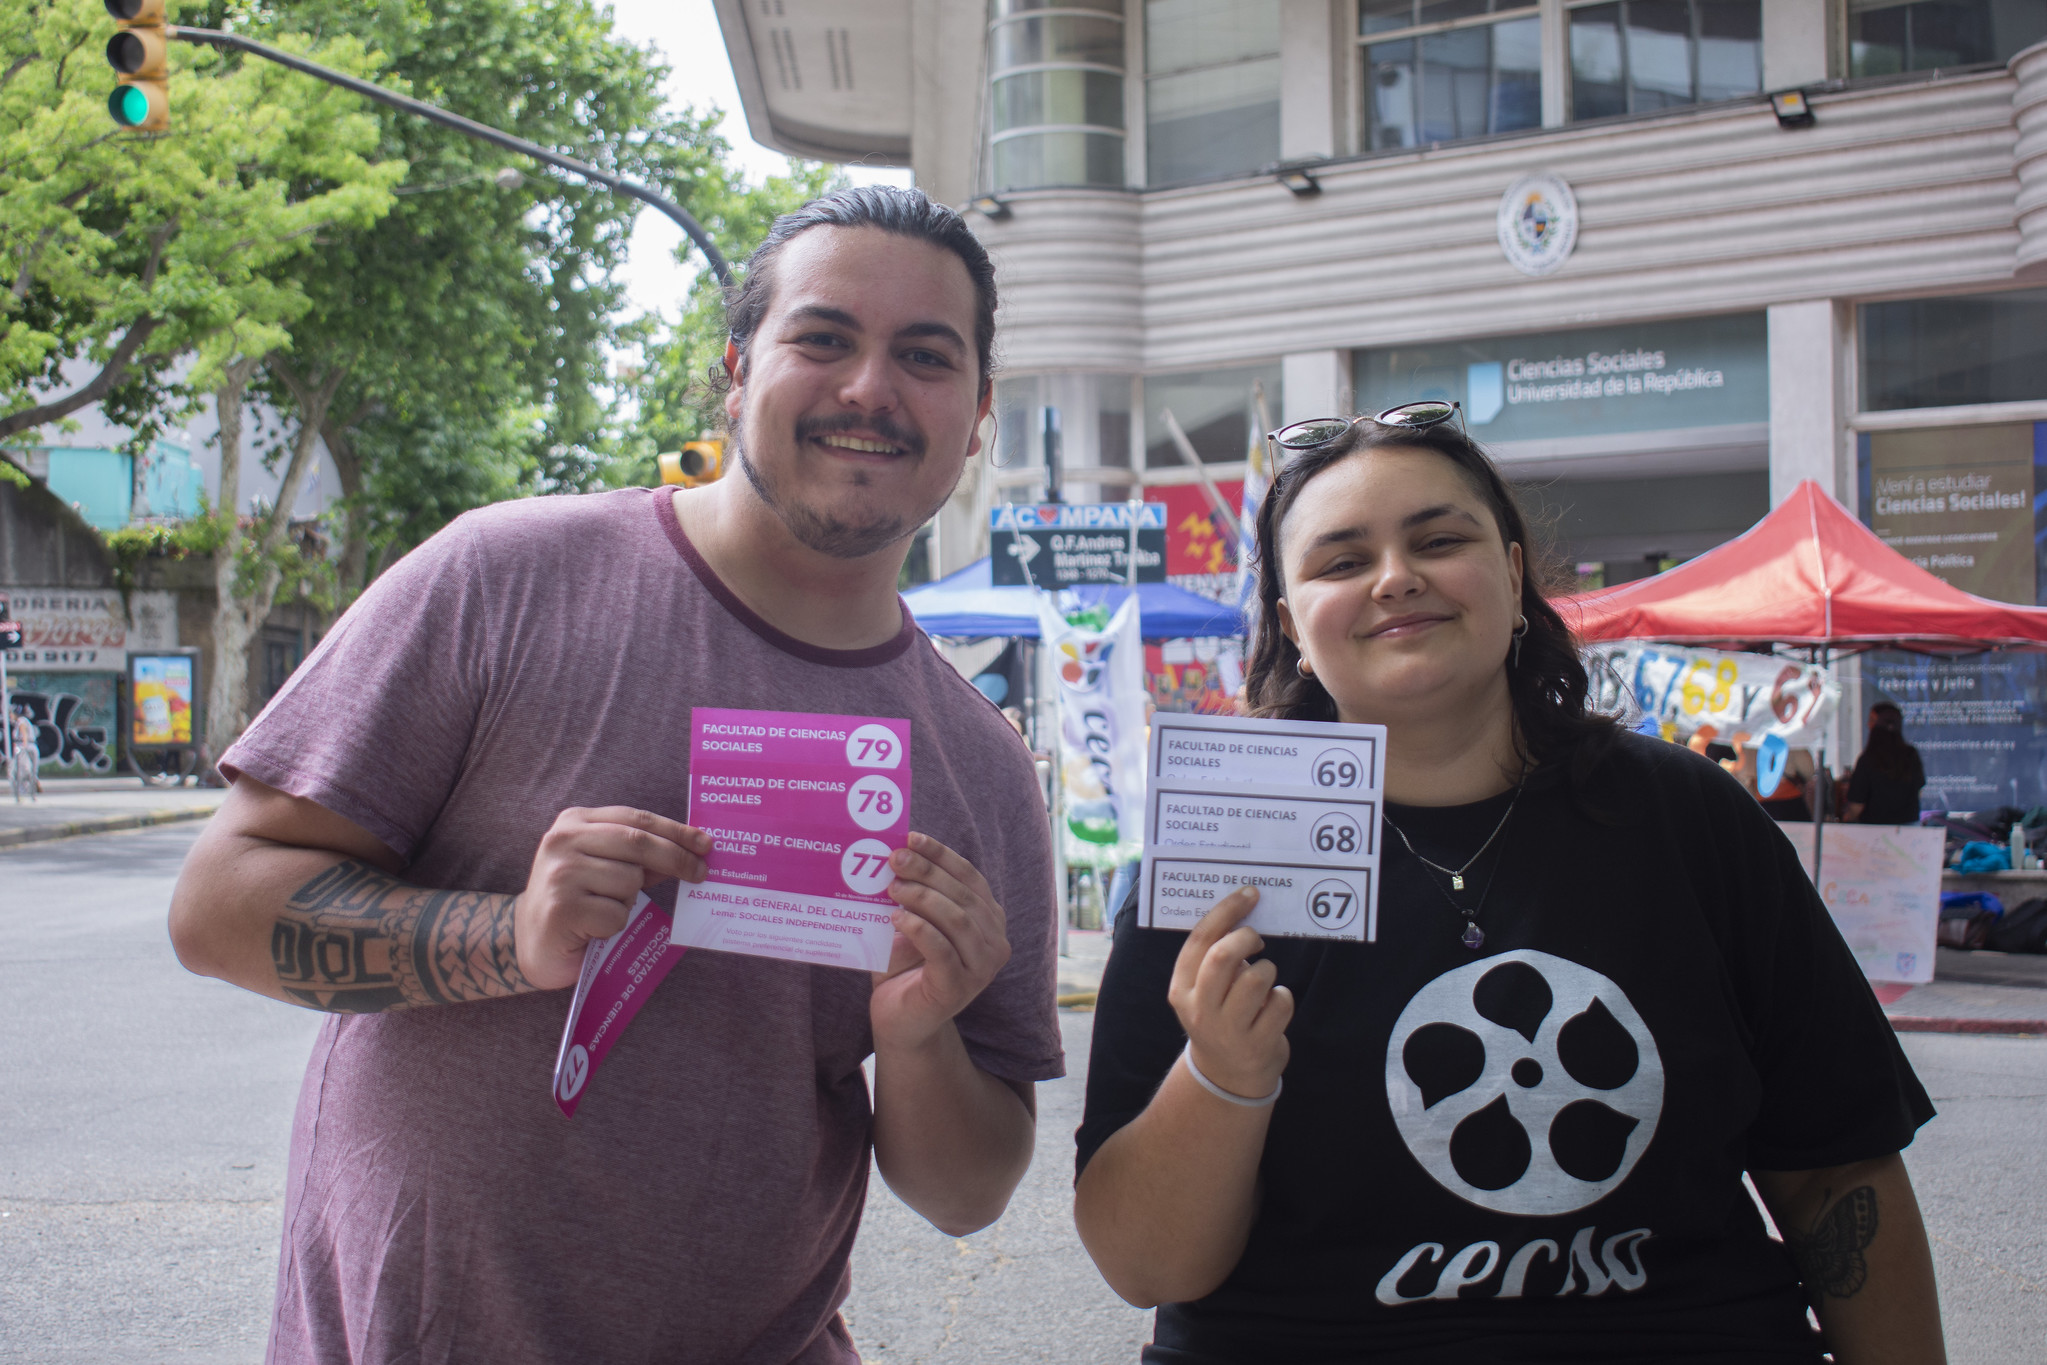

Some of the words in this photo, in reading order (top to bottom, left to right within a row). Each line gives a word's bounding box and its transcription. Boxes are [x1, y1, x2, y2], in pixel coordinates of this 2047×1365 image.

[1507, 355, 1585, 381] Ciencias
[1586, 347, 1666, 375] Sociales
[1507, 377, 1602, 404] Universidad
[1603, 376, 1626, 396] de
[1626, 374, 1643, 394] la
[1643, 368, 1724, 395] República
[1915, 481, 1925, 493] a
[1927, 472, 1992, 493] estudiar
[1875, 495, 1945, 515] Ciencias
[1948, 489, 2026, 512] Sociales!
[1930, 553, 1975, 569] Política
[1683, 657, 1738, 715] 68
[1878, 677, 1929, 691] febrero
[1932, 678, 1940, 692] y
[1942, 676, 1975, 692] julio
[702, 724, 766, 738] FACULTAD
[769, 727, 786, 738] DE
[788, 729, 846, 741] CIENCIAS
[702, 740, 763, 753] SOCIALES
[857, 738, 893, 761] 79
[1168, 740, 1226, 752] FACULTAD
[1229, 743, 1244, 754] DE
[1246, 744, 1298, 757] CIENCIAS
[1167, 755, 1221, 768] SOCIALES
[701, 775, 765, 789] FACULTAD
[768, 778, 785, 789] DE
[787, 780, 846, 792] CIENCIAS
[1316, 760, 1357, 788] 69
[700, 792, 762, 805] SOCIALES
[858, 789, 893, 814] 78
[1166, 804, 1224, 817] FACULTAD
[1227, 808, 1242, 818] DE
[1245, 809, 1297, 821] CIENCIAS
[1166, 819, 1219, 832] SOCIALES
[713, 840, 757, 855] CIALES
[764, 834, 782, 846] DE
[784, 837, 842, 854] CIENCIAS
[1315, 825, 1356, 853] 68
[721, 869, 768, 882] Estudiantil
[850, 852, 890, 879] 77
[1162, 871, 1220, 884] FACULTAD
[1223, 875, 1238, 885] DE
[1240, 876, 1293, 888] CIENCIAS
[1161, 887, 1215, 899] SOCIALES
[688, 889, 750, 906] ASAMBLEA
[752, 898, 804, 913] GENERAL
[807, 905, 828, 917] DEL
[831, 908, 890, 925] CLAUSTRO
[1160, 905, 1192, 916] Orden
[1311, 891, 1353, 919] 67
[631, 912, 653, 936] Orden
[711, 908, 737, 919] Lema:
[739, 912, 784, 925] SOCIALES
[785, 918, 863, 935] INDEPENDIENTES
[726, 927, 743, 936] Voto
[769, 934, 803, 944] siguientes
[604, 935, 635, 975] Estudiantil
[627, 925, 670, 976] SOCIALES
[634, 938, 672, 984] ACULTAD
[622, 985, 636, 1001] DE
[589, 1001, 624, 1052] CIENCIAS
[566, 1053, 584, 1094] 77
